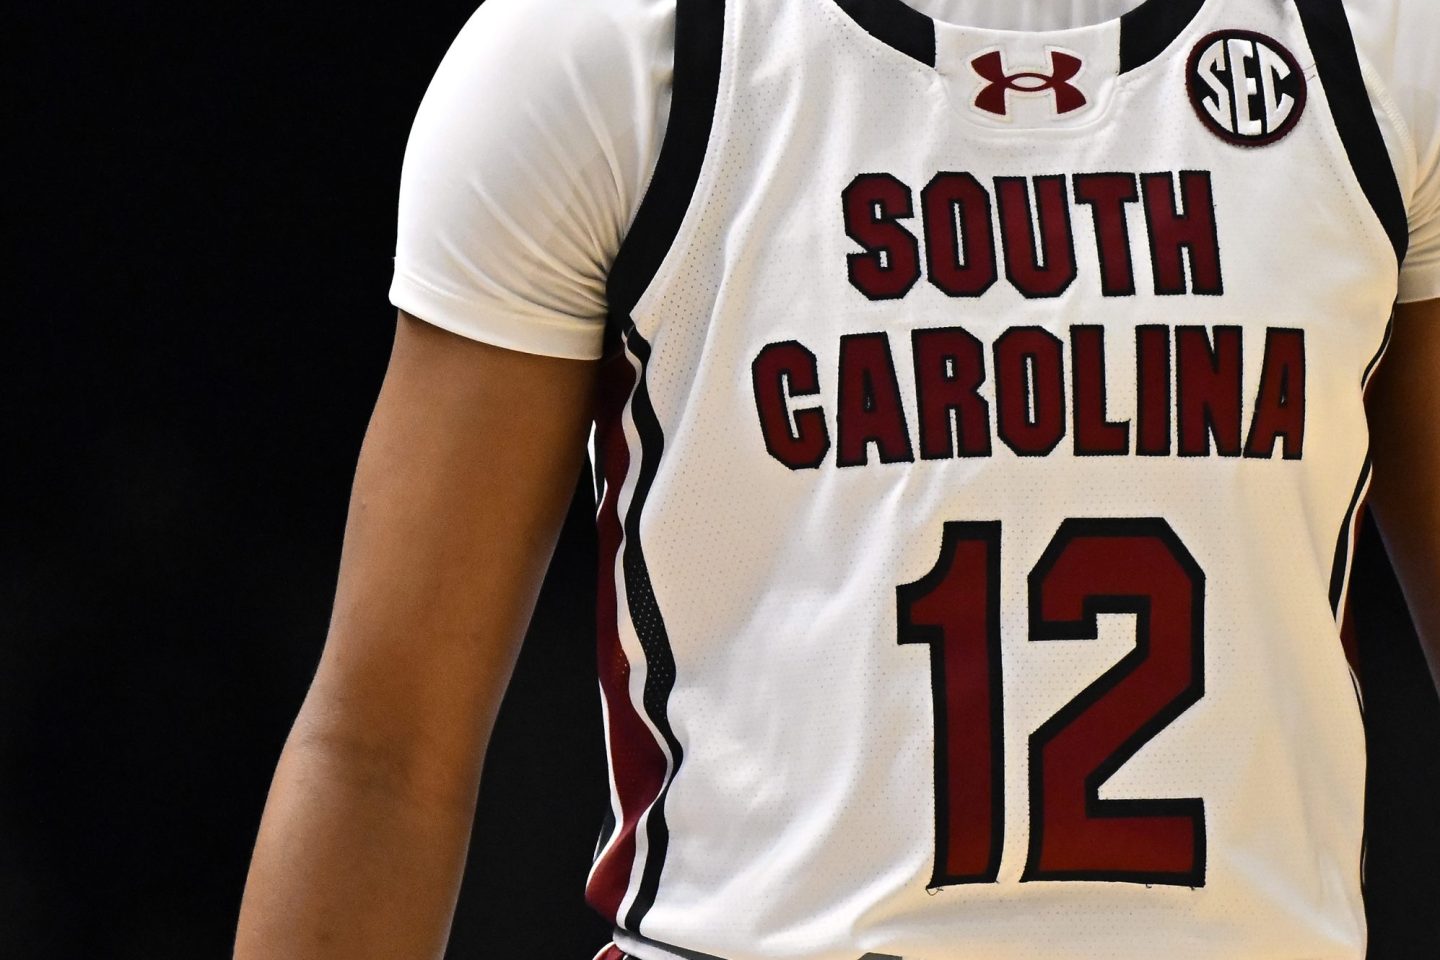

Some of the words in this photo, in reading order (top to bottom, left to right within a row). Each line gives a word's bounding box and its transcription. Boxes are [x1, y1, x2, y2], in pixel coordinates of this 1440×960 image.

[1197, 38, 1295, 136] SEC
[841, 170, 1223, 301] SOUTH
[751, 323, 1305, 471] CAROLINA
[896, 517, 1206, 890] 12
